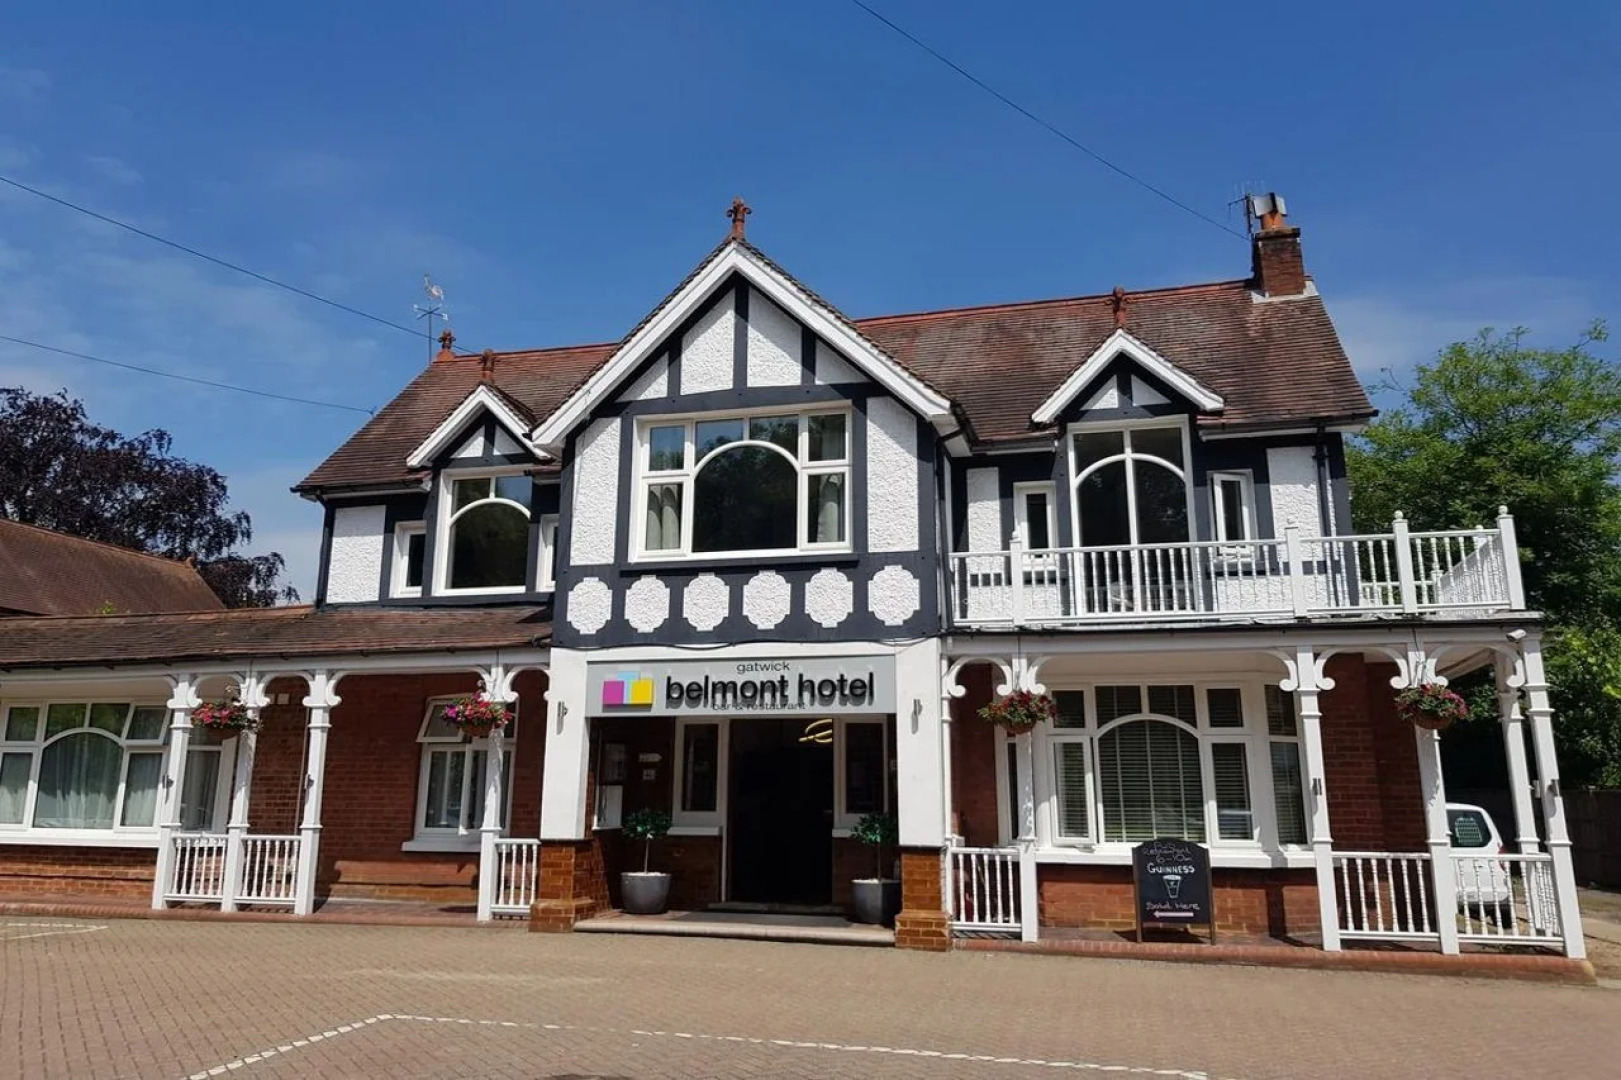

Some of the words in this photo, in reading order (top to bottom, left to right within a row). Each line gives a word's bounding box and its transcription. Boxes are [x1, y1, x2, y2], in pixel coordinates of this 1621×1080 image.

[736, 661, 790, 675] gatwick
[666, 674, 789, 703] belmont
[798, 672, 874, 701] hotel
